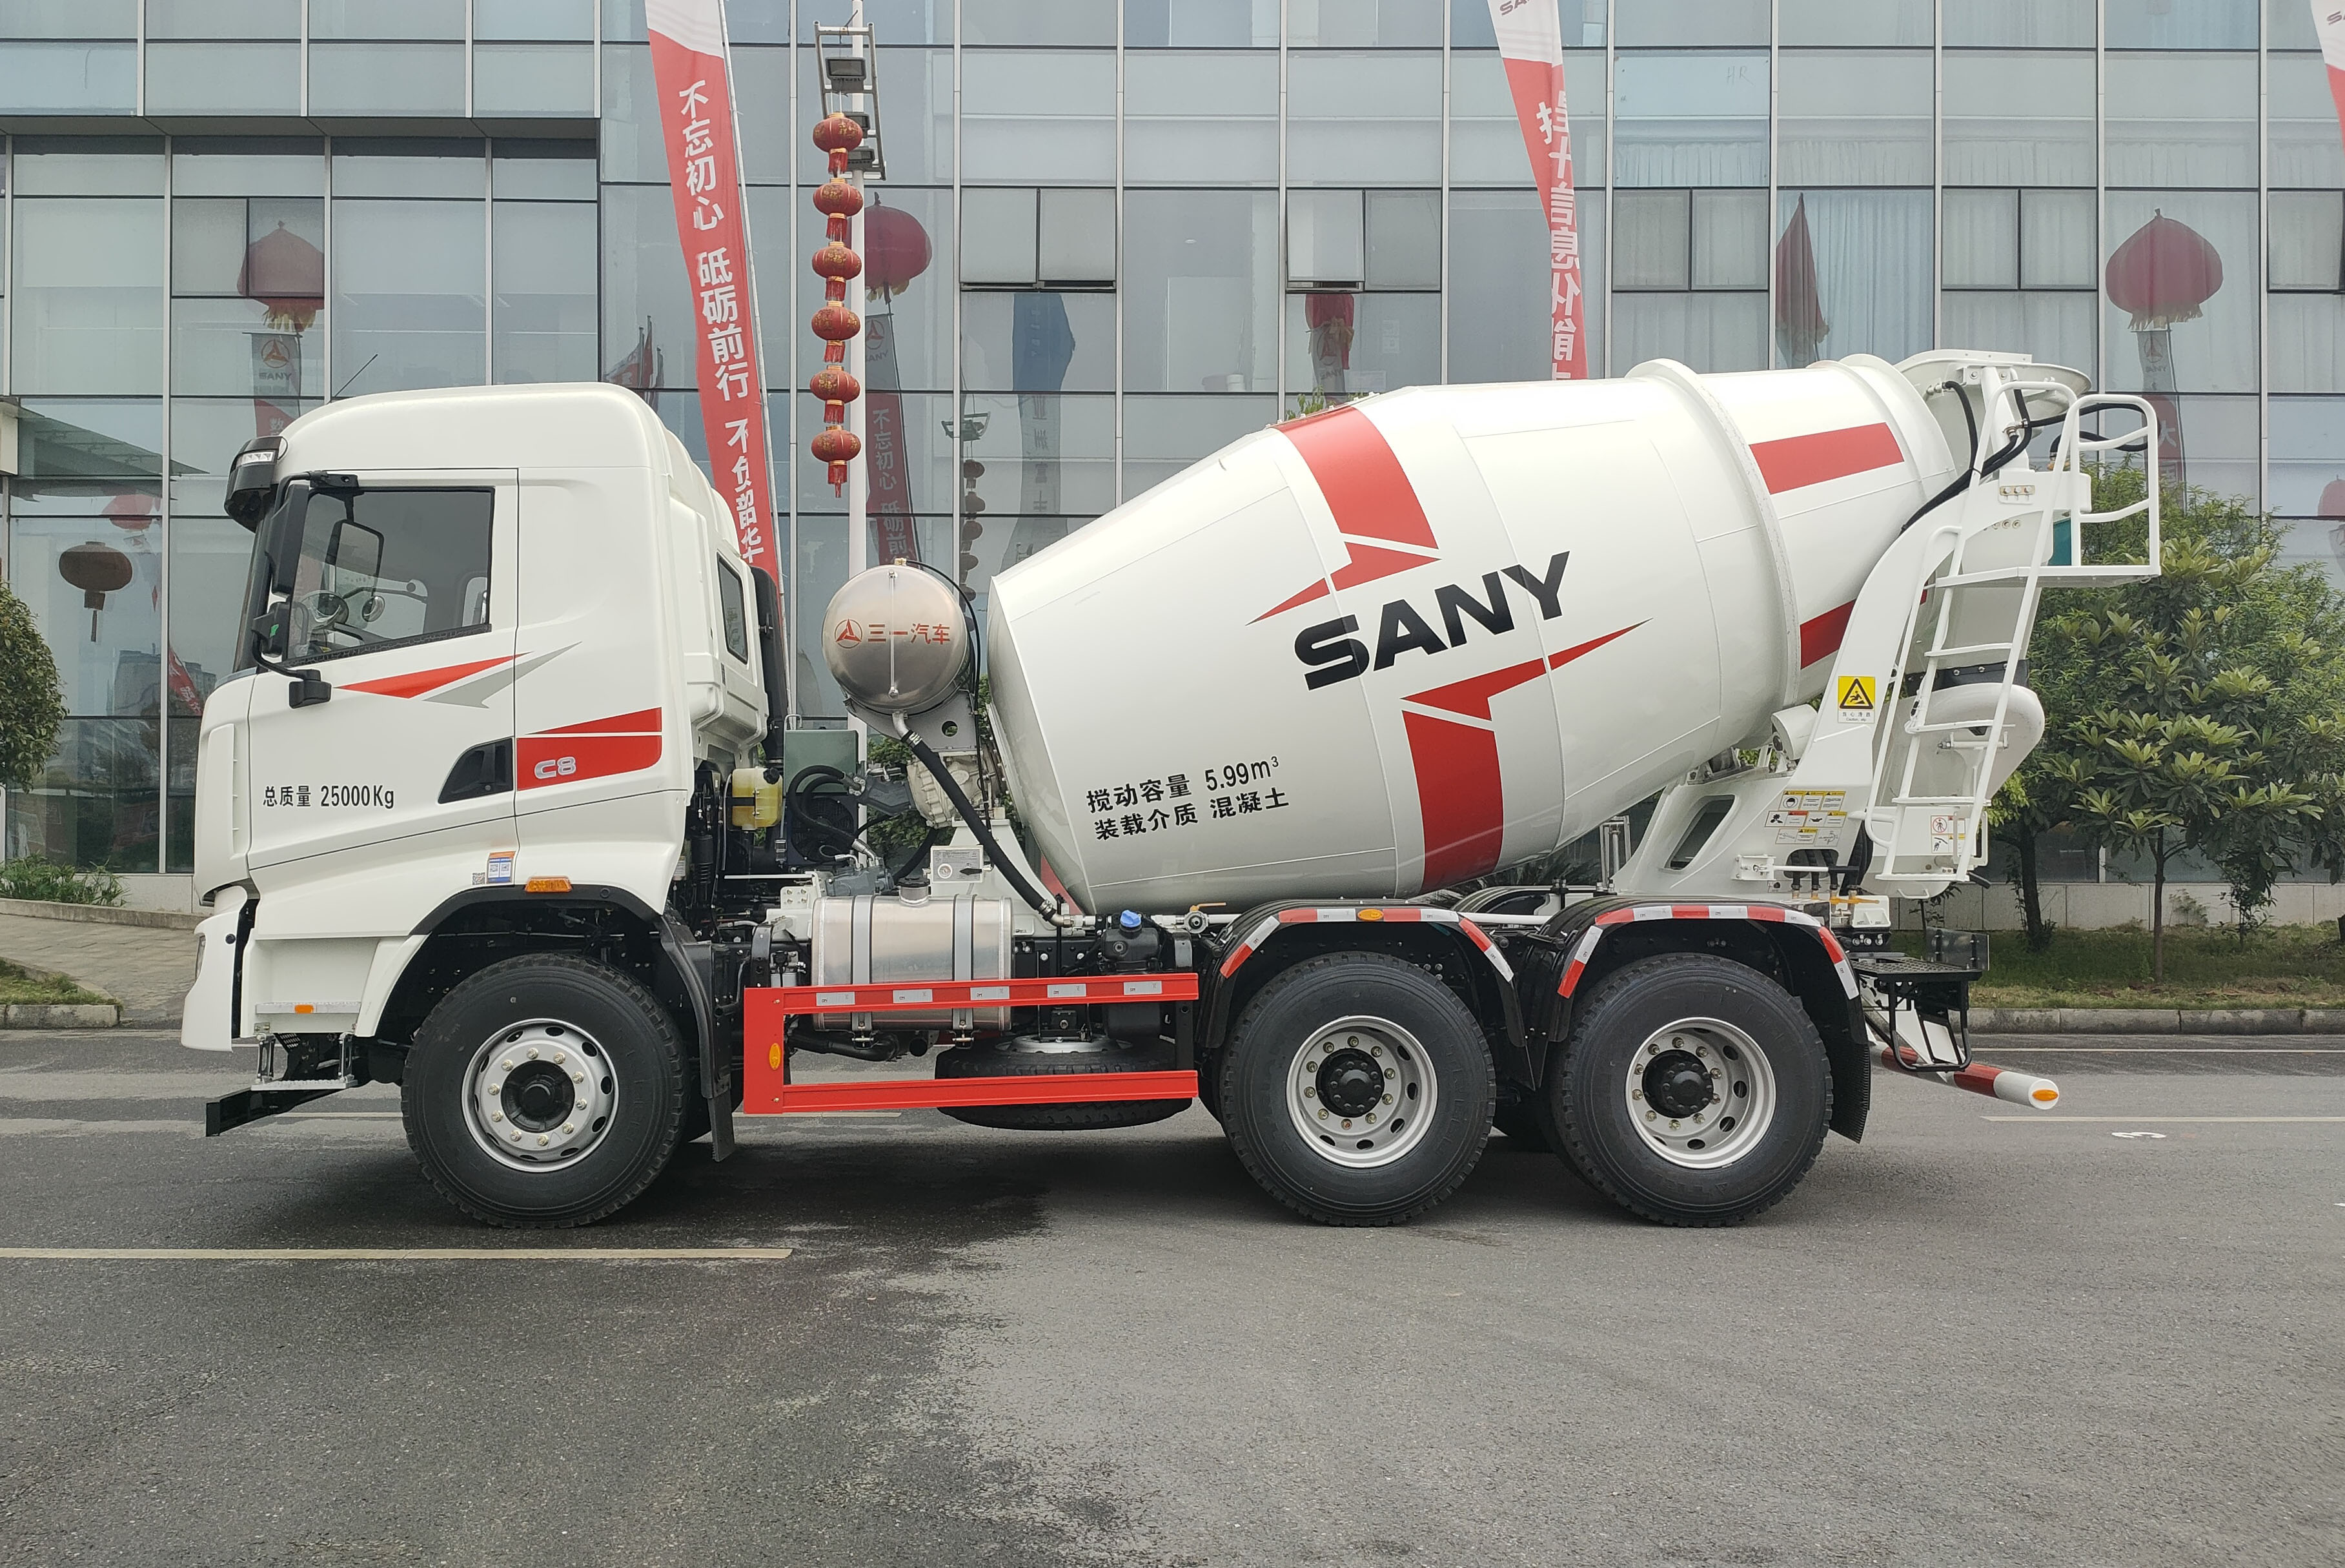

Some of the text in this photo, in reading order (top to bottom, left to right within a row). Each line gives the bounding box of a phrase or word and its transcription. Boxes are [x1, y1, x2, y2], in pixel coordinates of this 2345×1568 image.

[679, 79, 724, 230] 不忘初心
[696, 247, 749, 402] 砥砺前行
[259, 372, 292, 380] SANY
[872, 408, 897, 491] 不忘初心
[868, 623, 950, 645] 三一汽车
[1294, 551, 1570, 690] SANY
[534, 756, 577, 779] C8
[263, 785, 394, 809] 总质量 25000Kg
[1086, 773, 1192, 813] 搅动容量
[1095, 787, 1290, 840] 装载介质 混凝土
